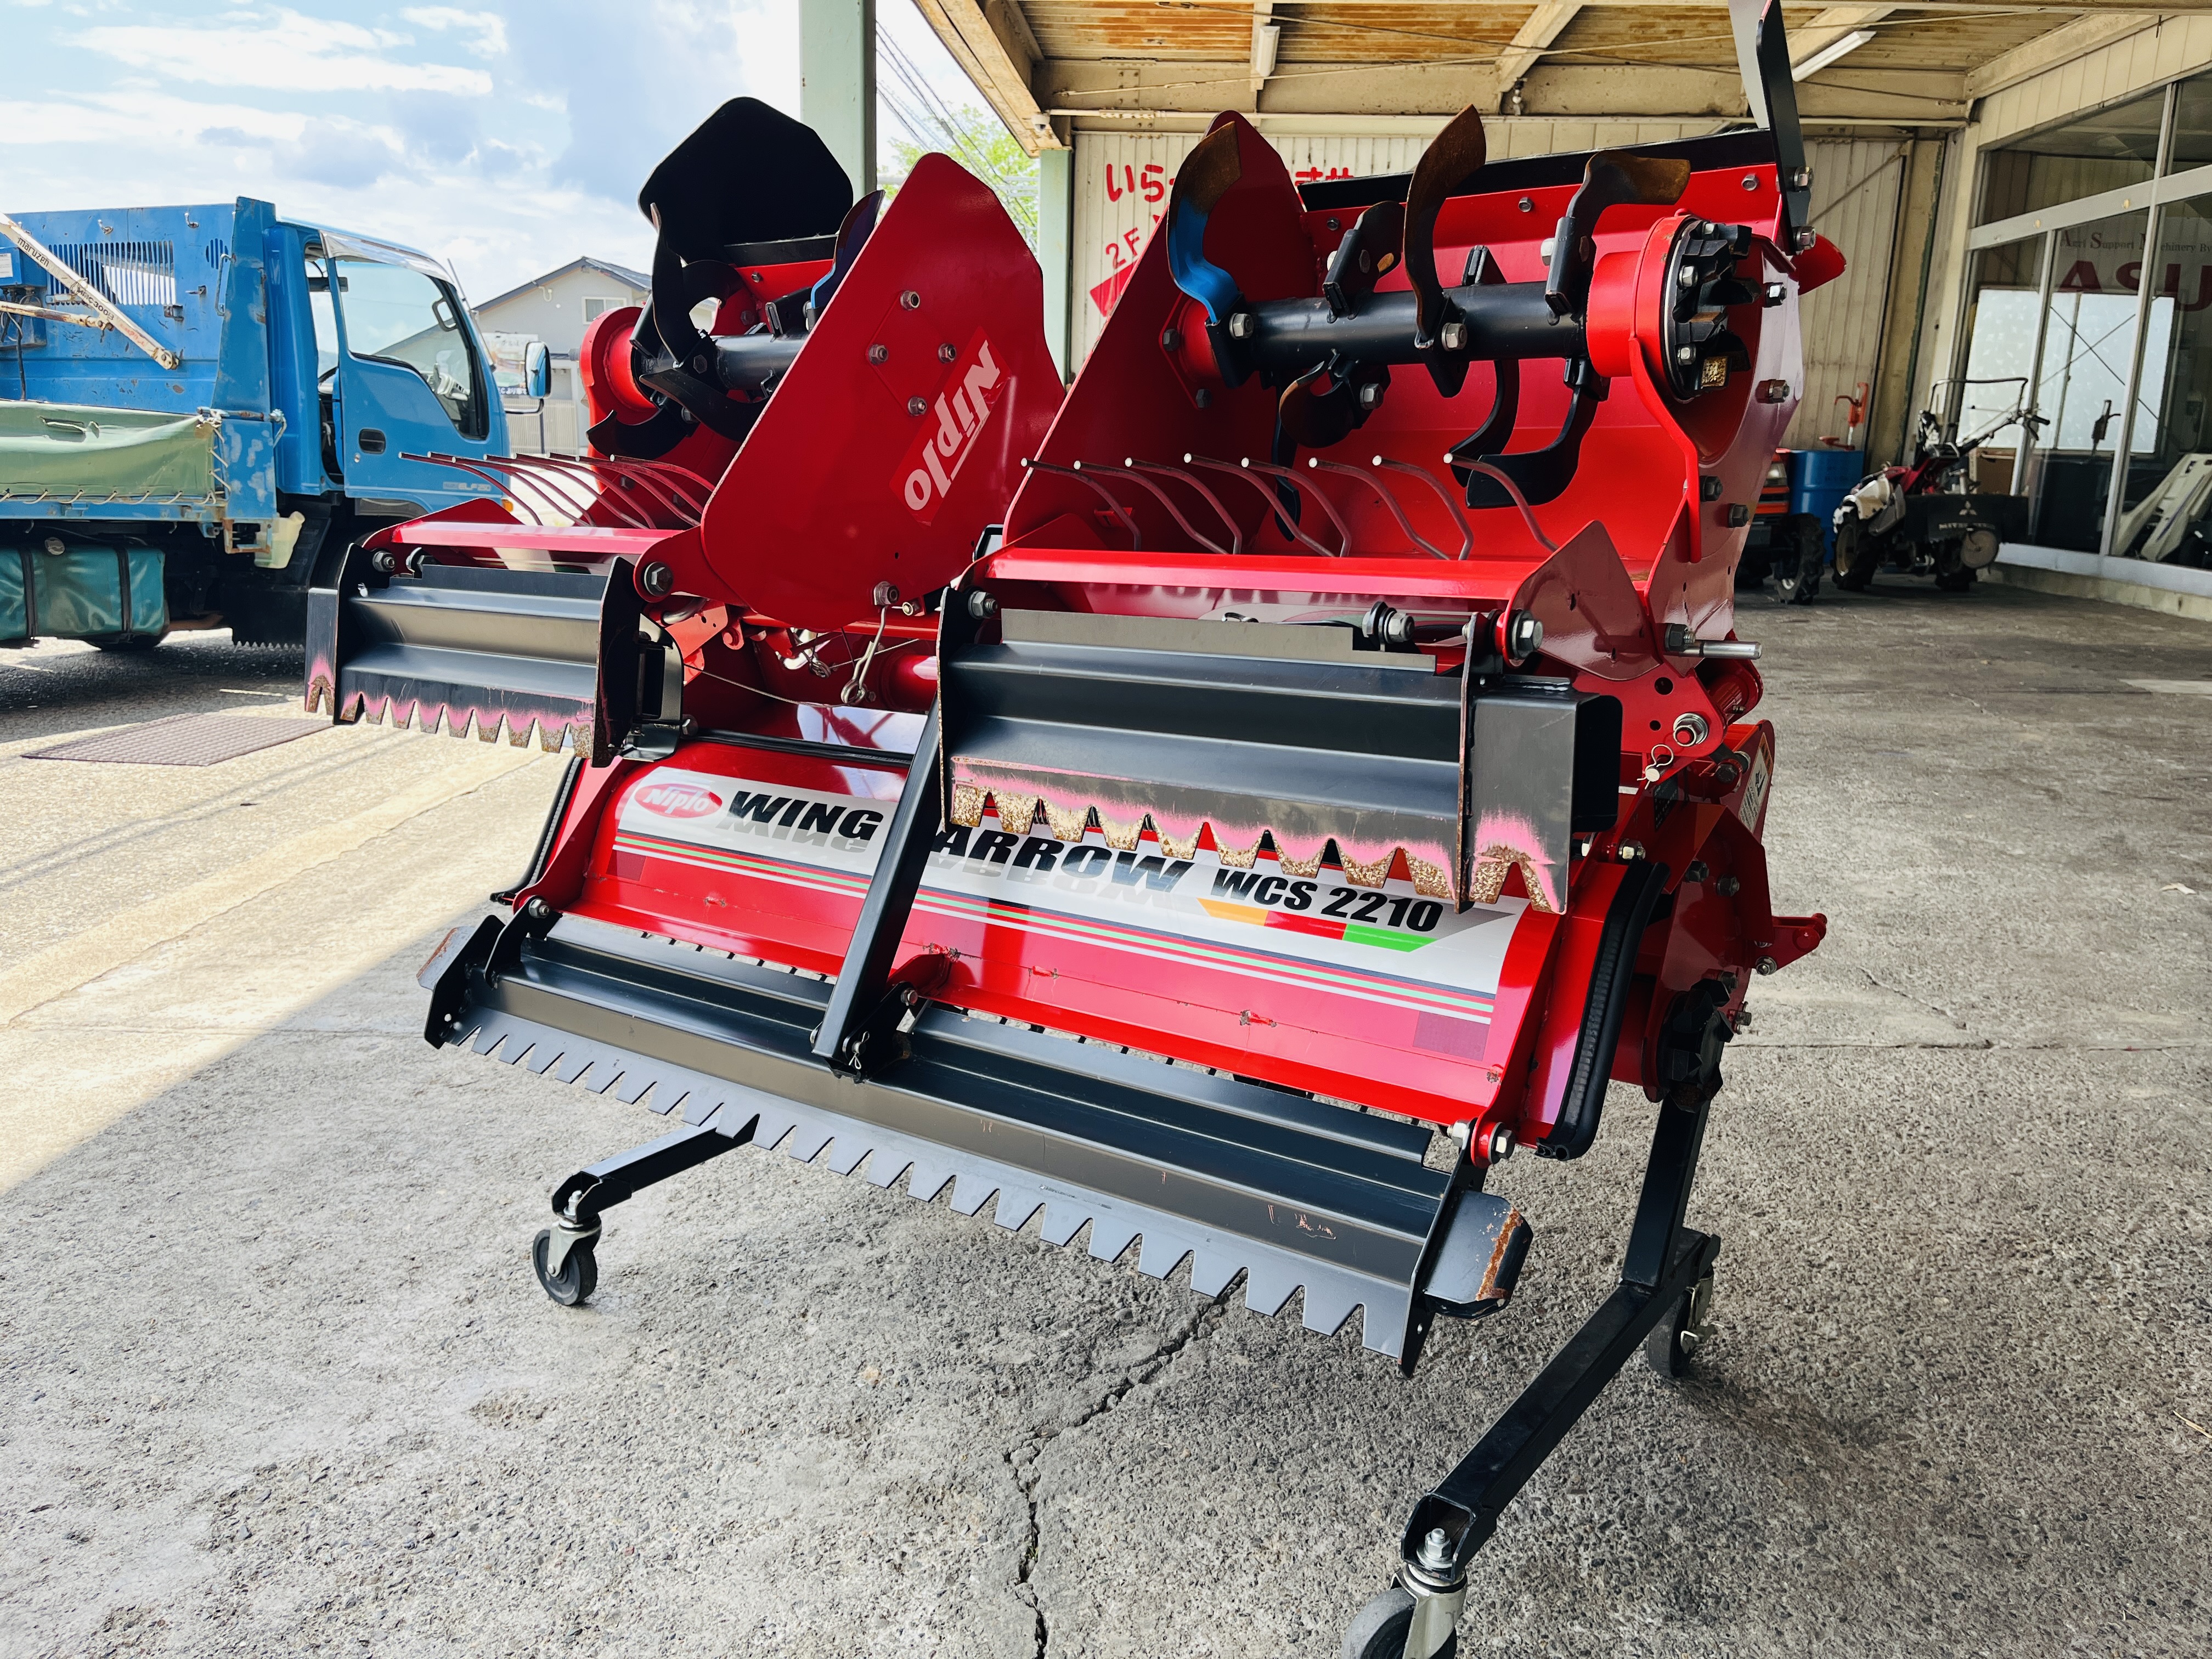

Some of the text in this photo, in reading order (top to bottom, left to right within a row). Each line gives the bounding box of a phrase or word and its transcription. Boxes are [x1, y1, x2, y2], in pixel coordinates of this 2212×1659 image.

[17, 237, 49, 268] maruzen
[1105, 228, 1140, 270] 2F
[904, 339, 1001, 510] Niplo
[643, 786, 1195, 893] Niplo WING ARROW
[1210, 868, 1444, 932] WCS 2210
